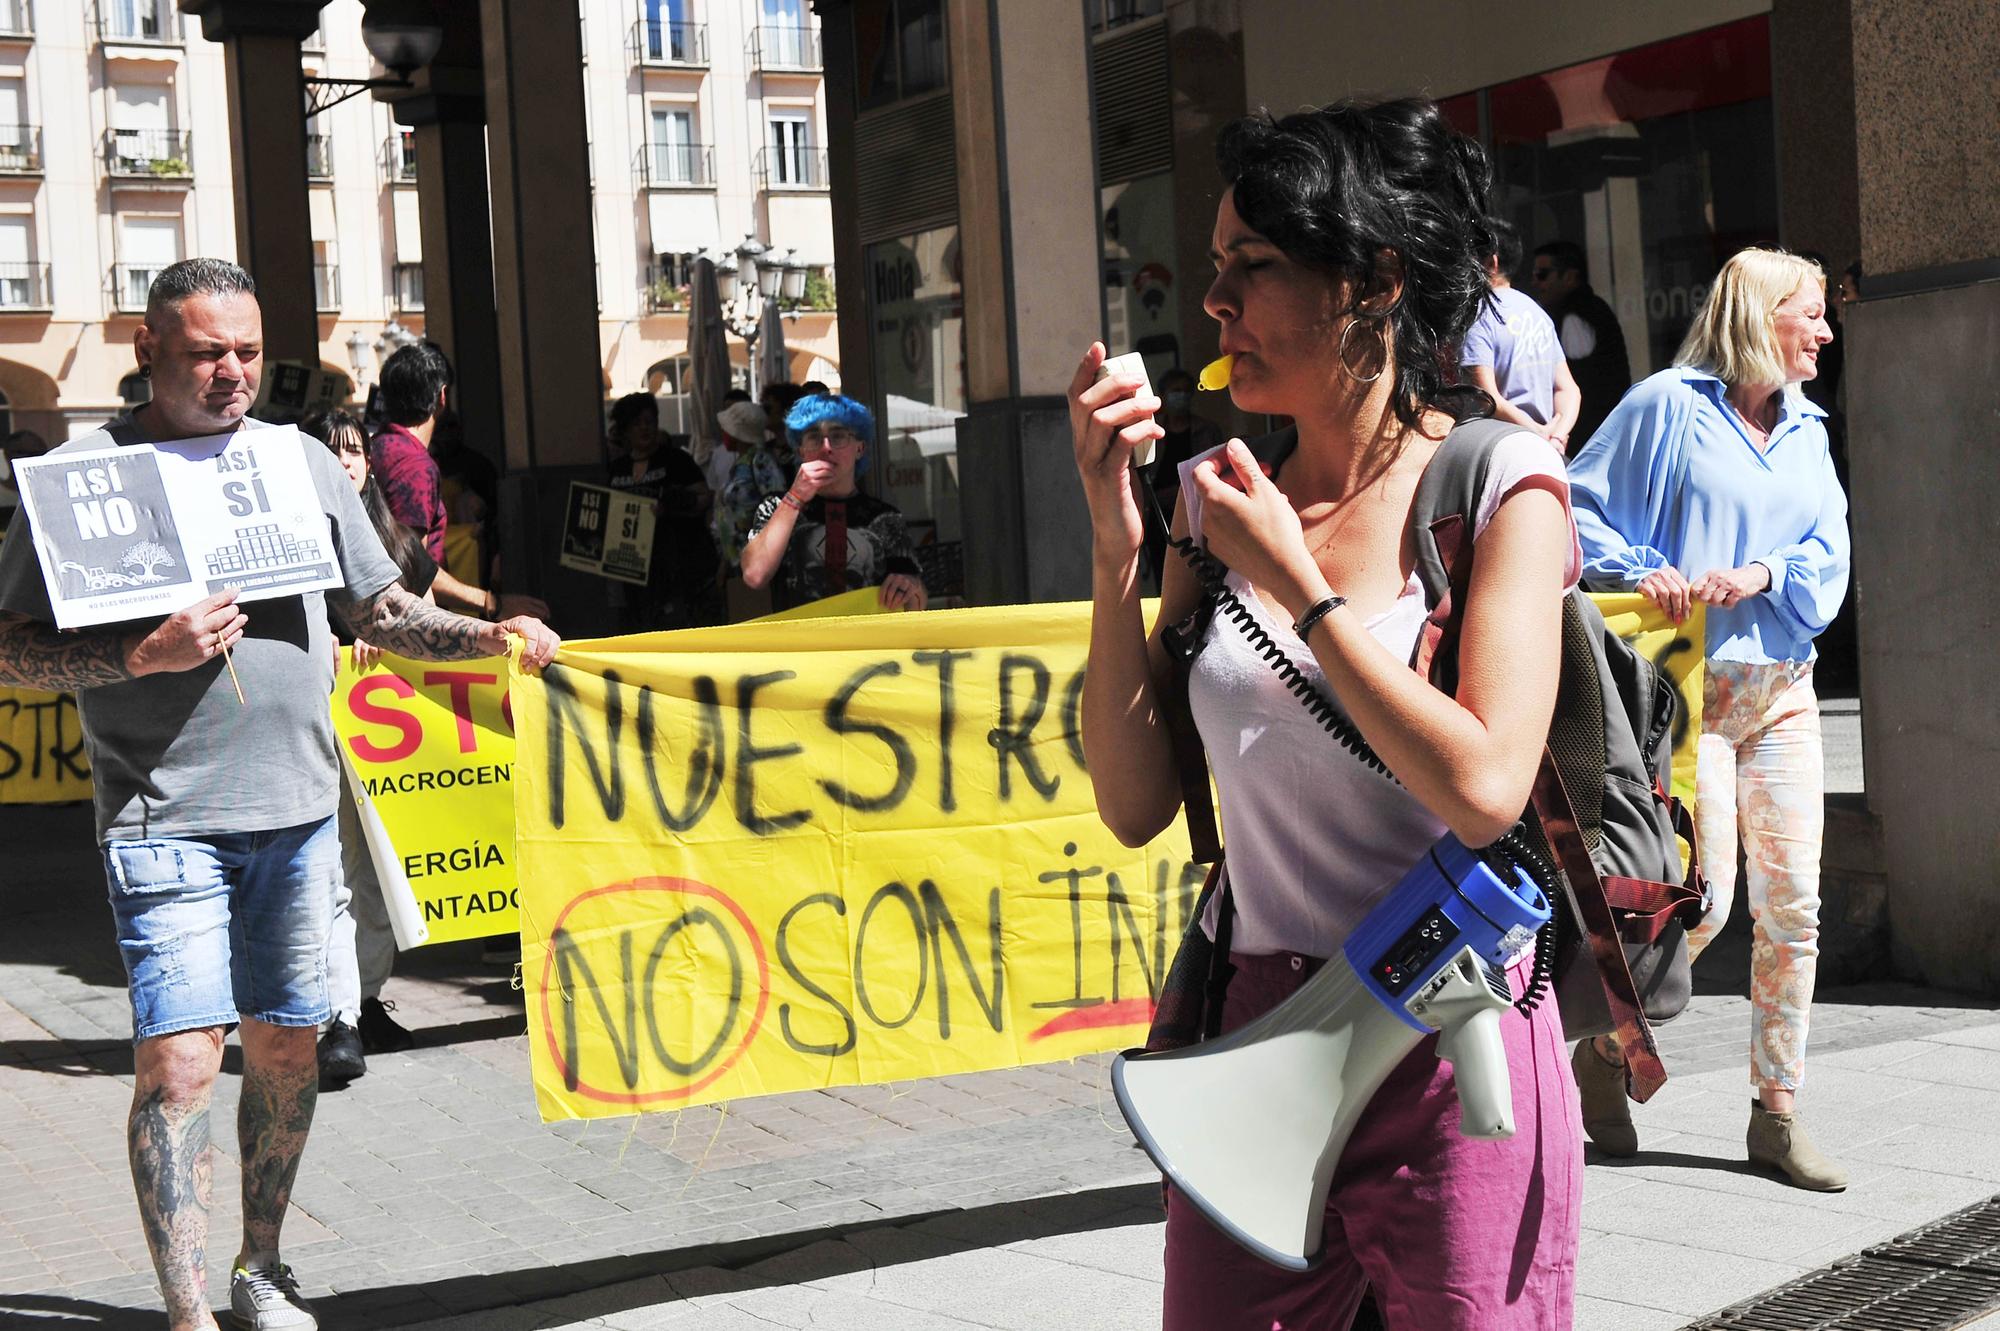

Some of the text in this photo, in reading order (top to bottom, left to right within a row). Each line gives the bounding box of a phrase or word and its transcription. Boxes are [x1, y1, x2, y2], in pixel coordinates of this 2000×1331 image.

[875, 254, 914, 304] Hola
[66, 461, 123, 498] ASÍ
[216, 446, 257, 473] ASÍ
[222, 471, 271, 517] SÍ
[71, 496, 138, 541] NO
[579, 507, 599, 531] NO
[622, 515, 640, 540] SÍ
[347, 670, 516, 765] ST
[361, 763, 516, 798] MACROCEN
[550, 906, 743, 1092] NO
[775, 878, 1003, 1058] SON
